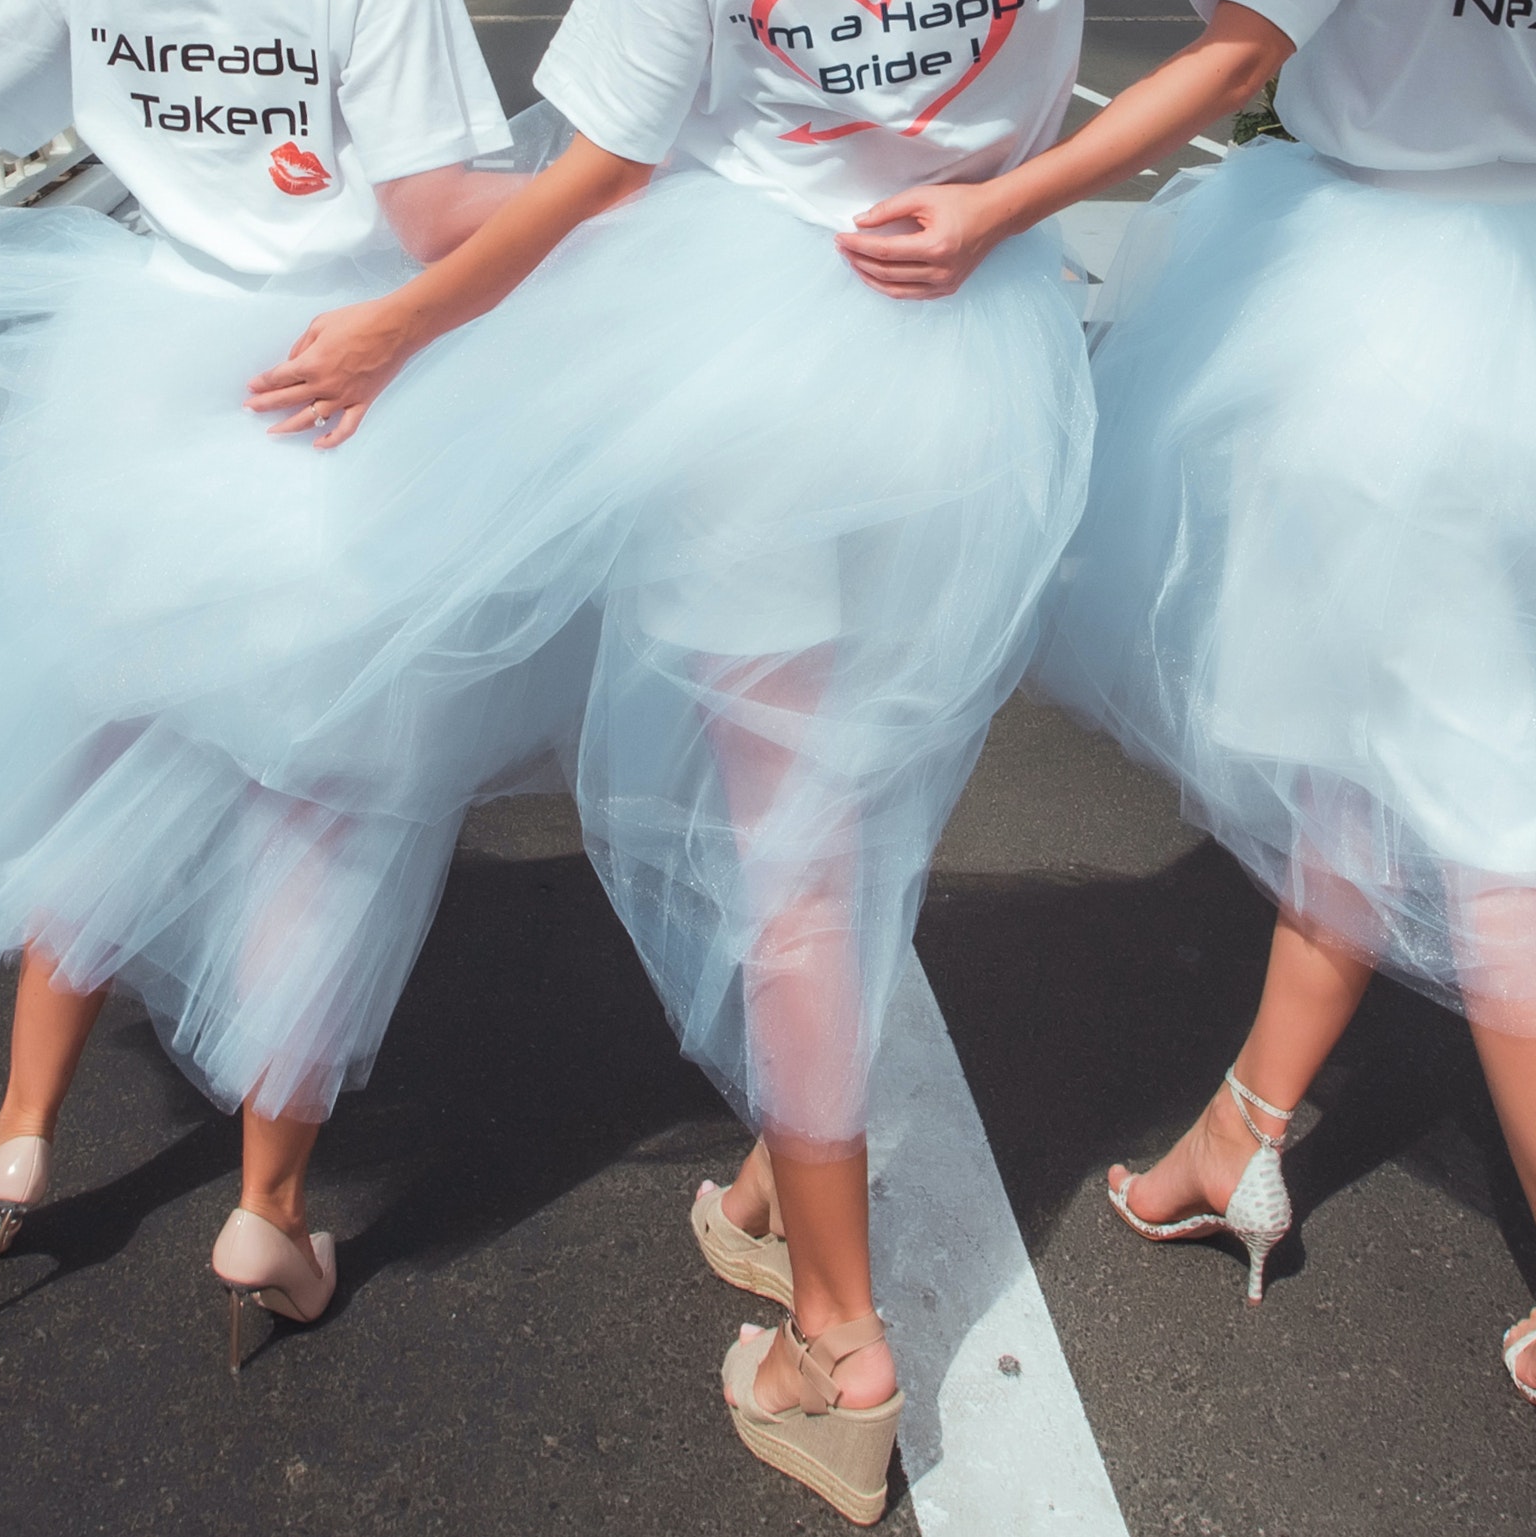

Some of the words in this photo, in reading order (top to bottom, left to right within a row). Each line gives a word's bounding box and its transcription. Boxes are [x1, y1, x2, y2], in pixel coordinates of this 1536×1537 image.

[831, 14, 862, 42] a
[90, 27, 319, 86] "Already
[130, 92, 308, 137] Taken!
